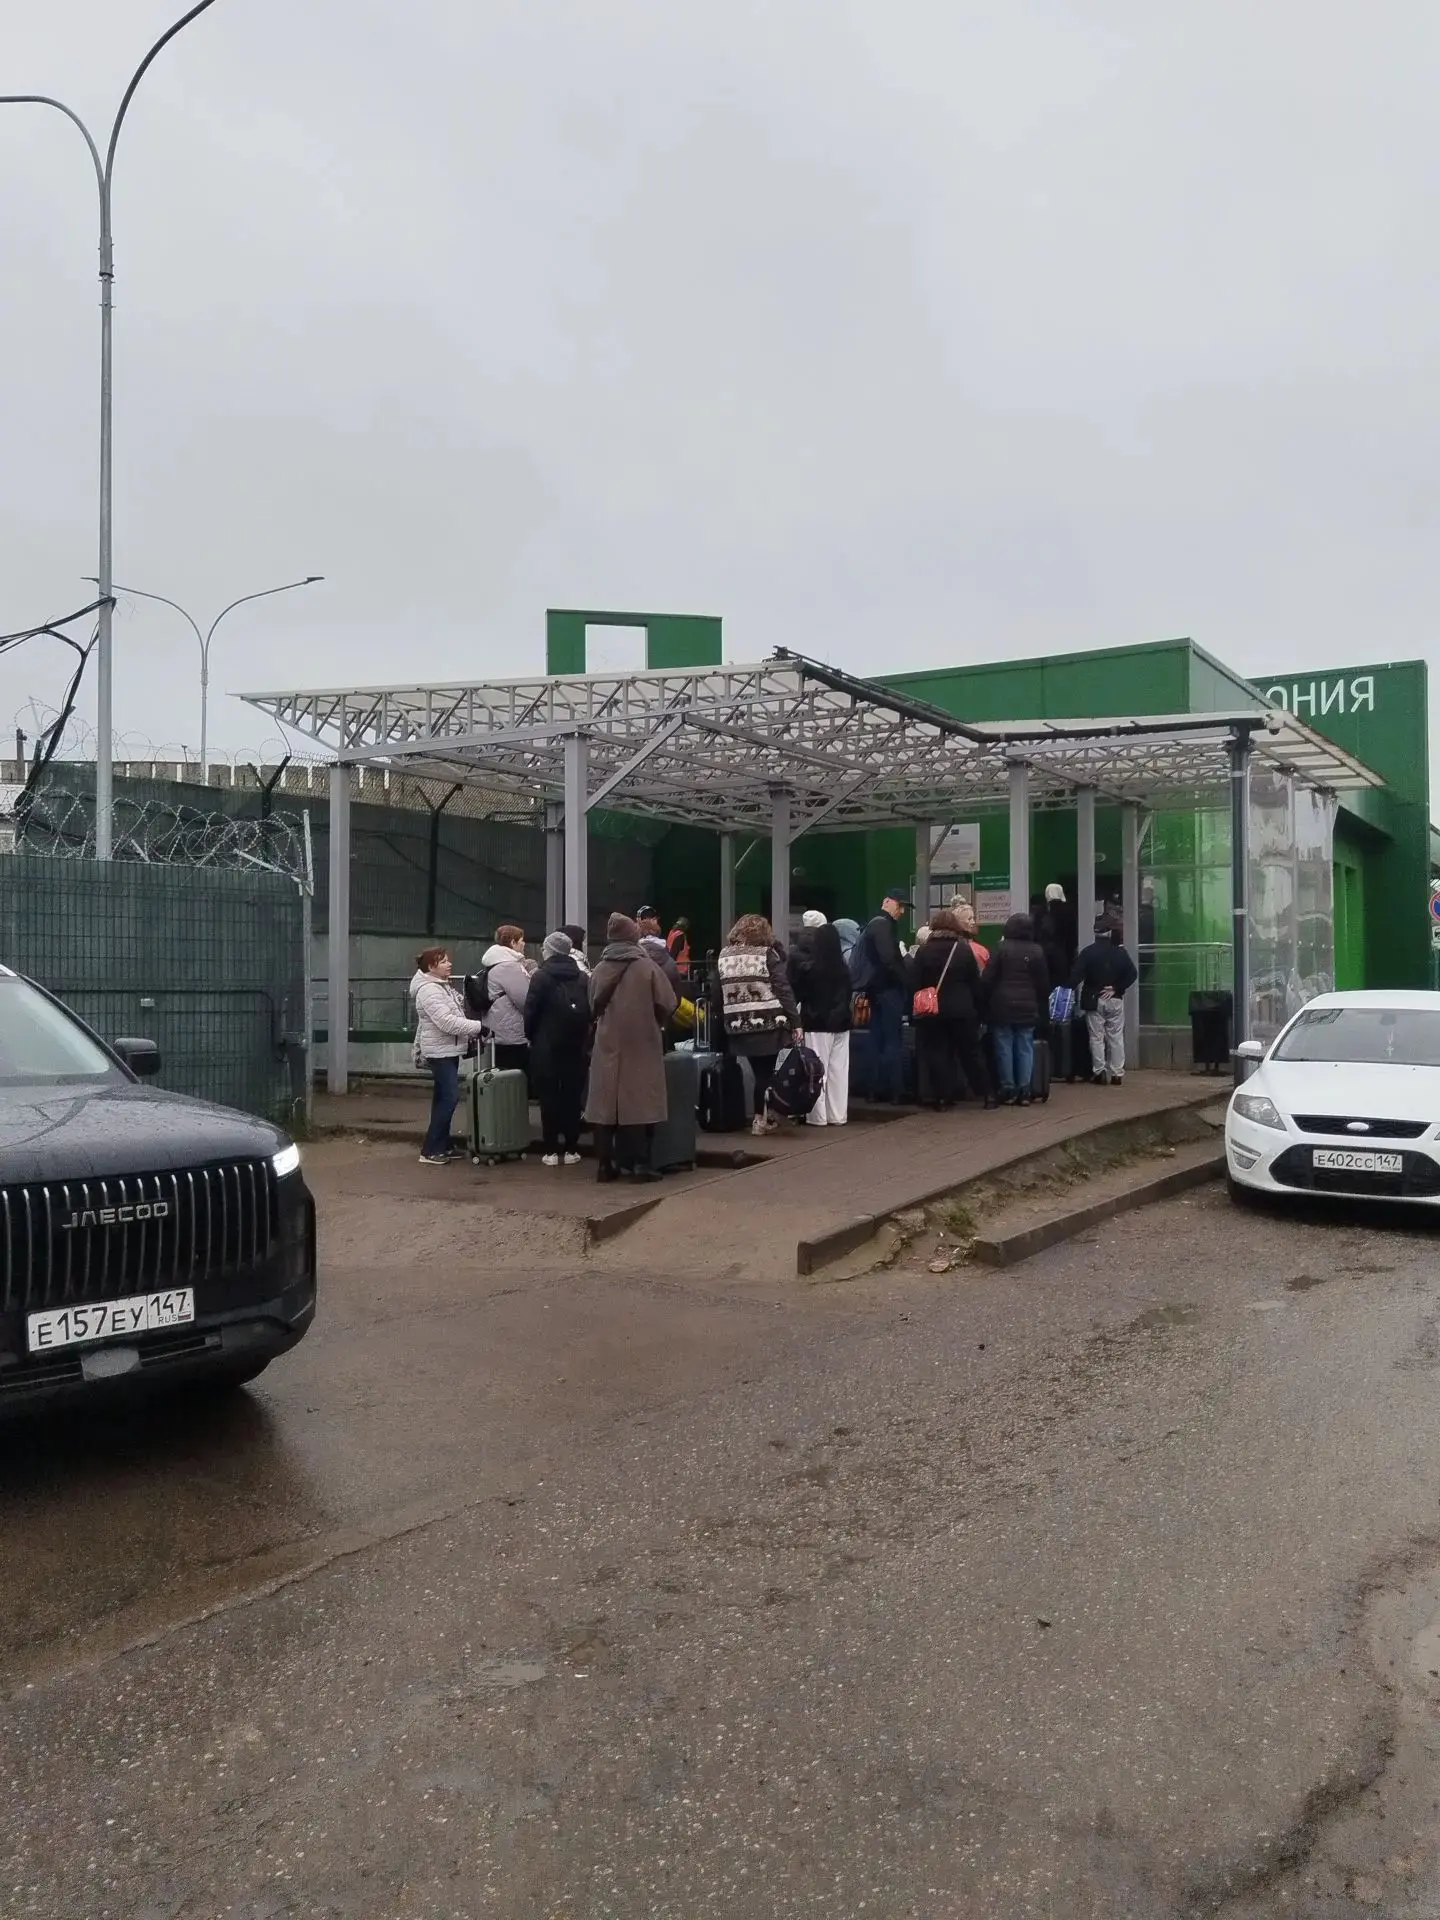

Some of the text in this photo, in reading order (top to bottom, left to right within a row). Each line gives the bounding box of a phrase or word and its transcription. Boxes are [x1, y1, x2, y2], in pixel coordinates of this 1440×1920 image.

[1377, 1155, 1398, 1167] 147
[62, 1202, 168, 1228] JAECOO
[150, 1291, 188, 1317] 147
[158, 1313, 178, 1325] RUS
